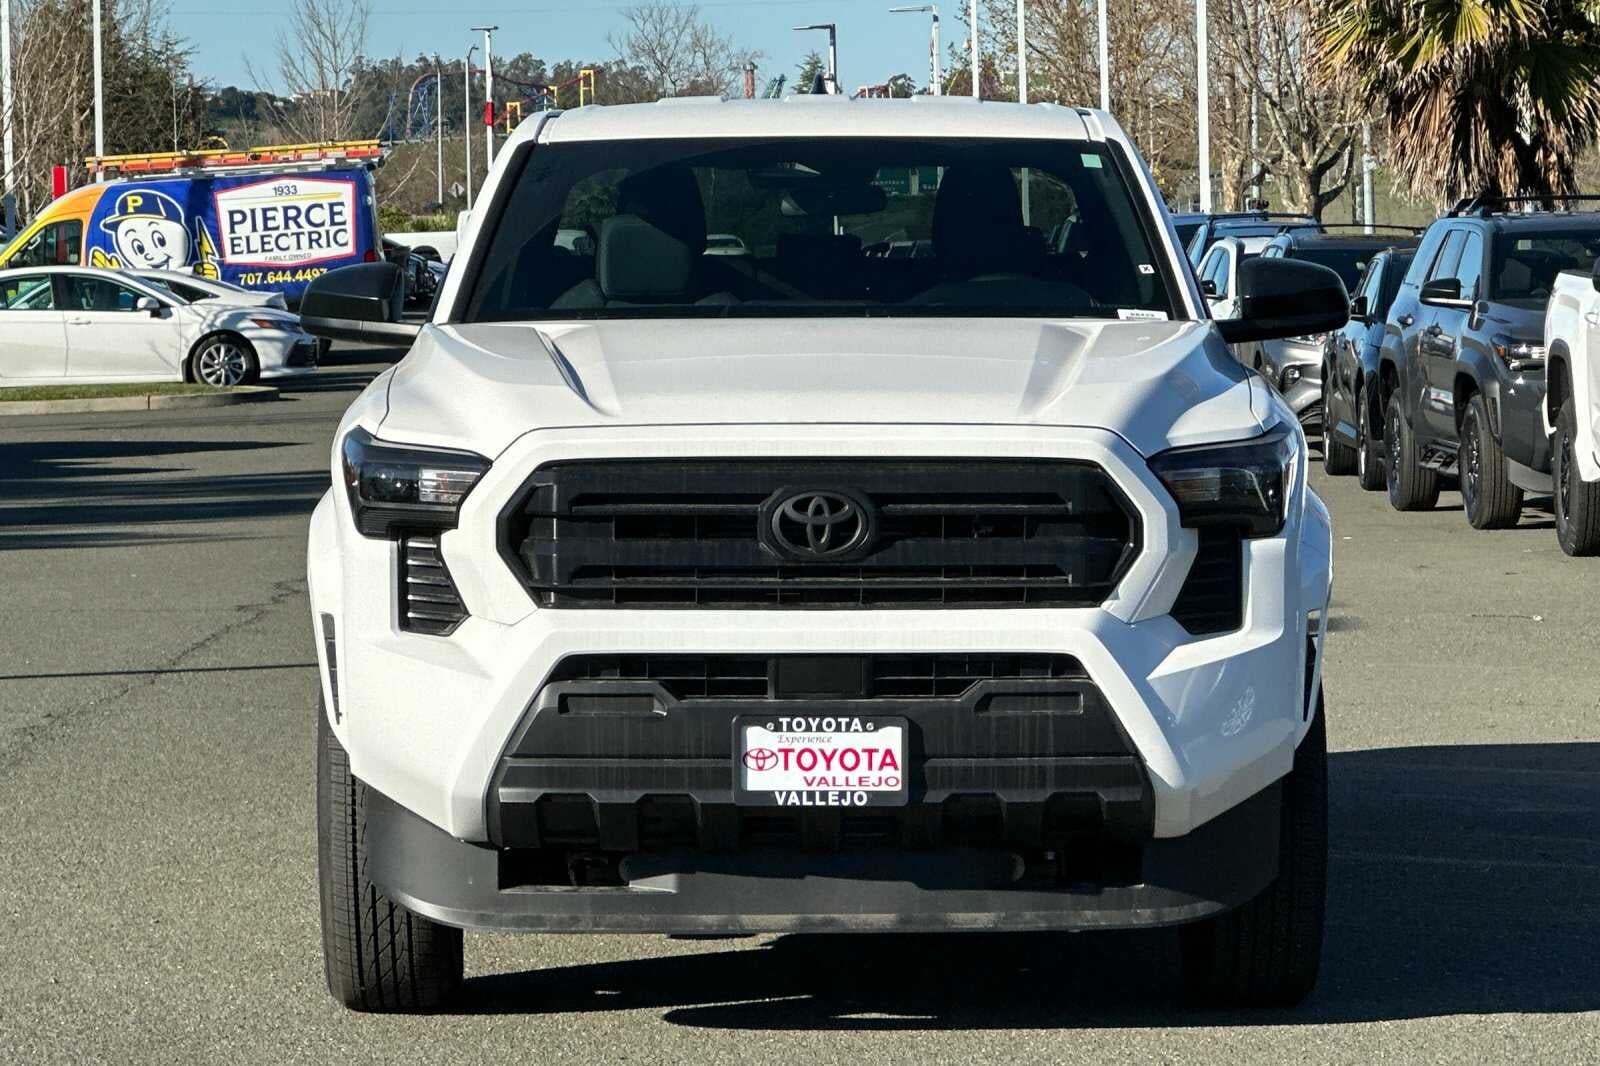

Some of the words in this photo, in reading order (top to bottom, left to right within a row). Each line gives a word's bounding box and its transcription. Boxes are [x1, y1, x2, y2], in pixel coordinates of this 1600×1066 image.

[272, 185, 298, 197] 1933
[127, 195, 143, 212] P
[228, 201, 347, 234] PIERCE
[228, 228, 349, 255] ELECTRIC
[778, 717, 863, 732] TOYOTA
[777, 735, 833, 745] Experience
[777, 747, 899, 772] TOYOTA
[803, 776, 900, 787] VALLEJO
[774, 790, 868, 806] VALLEJO
